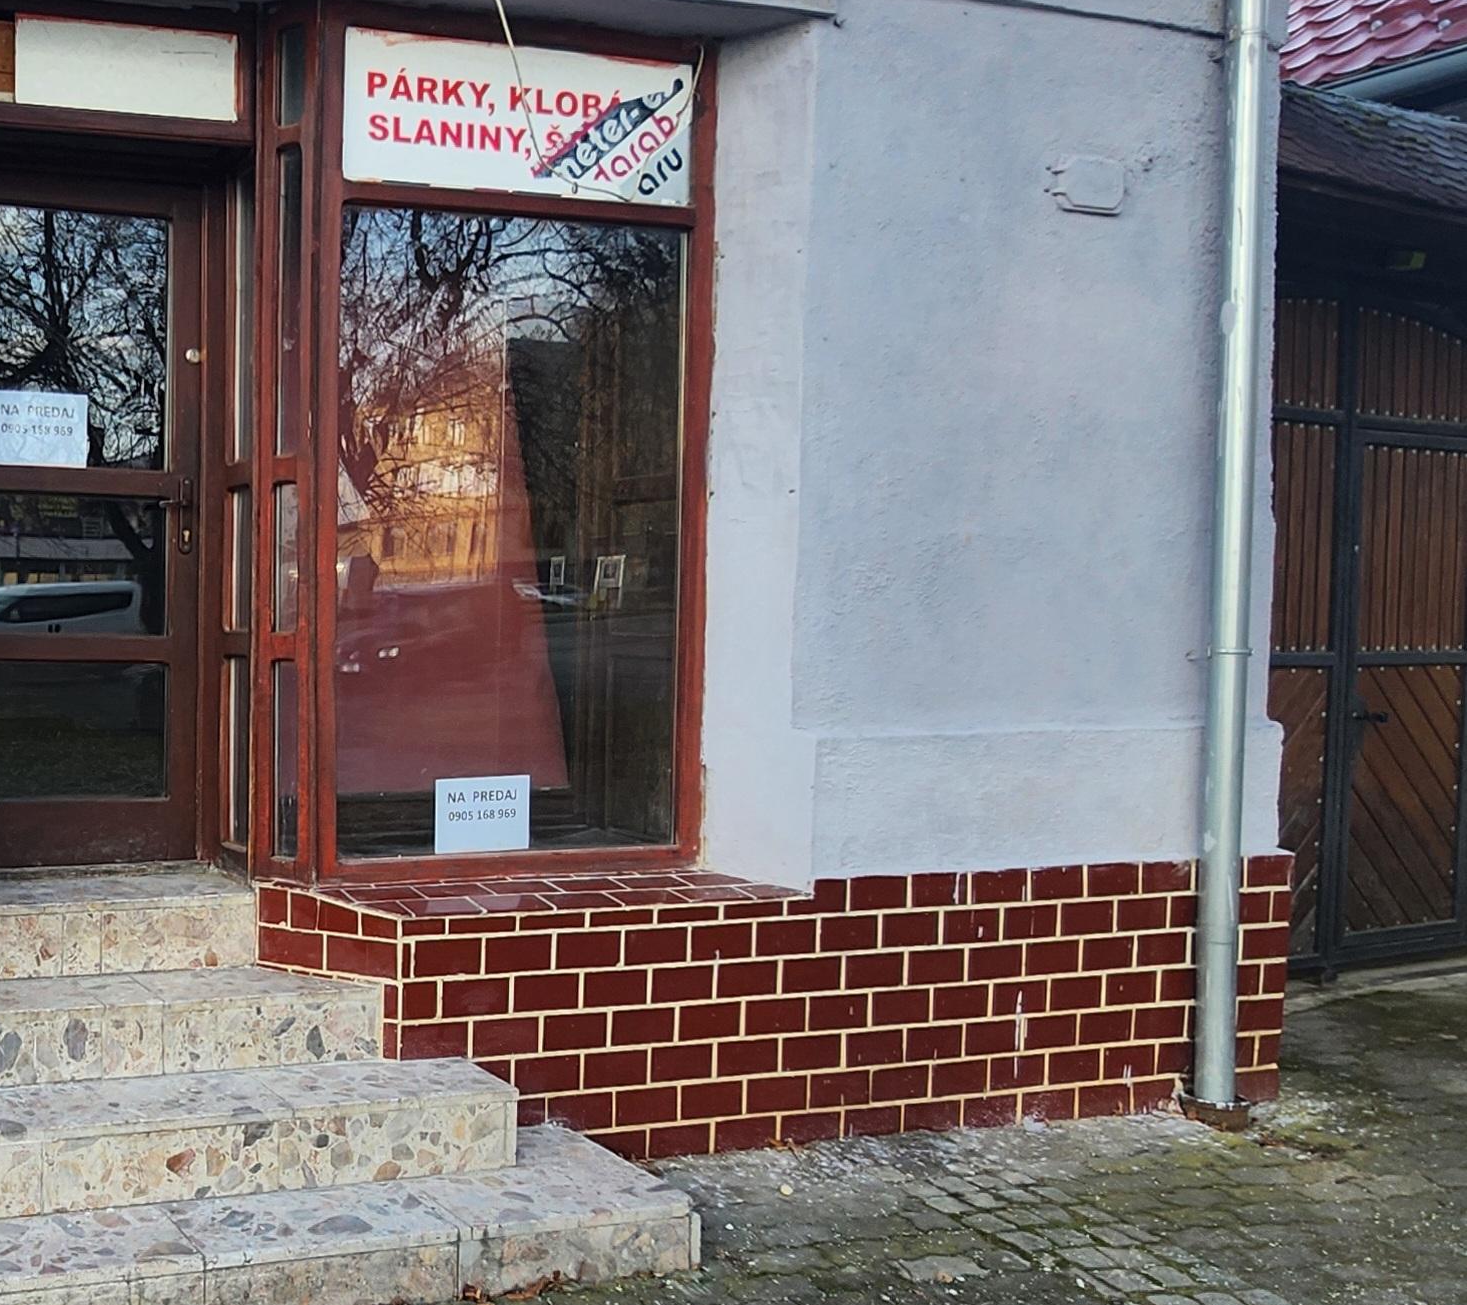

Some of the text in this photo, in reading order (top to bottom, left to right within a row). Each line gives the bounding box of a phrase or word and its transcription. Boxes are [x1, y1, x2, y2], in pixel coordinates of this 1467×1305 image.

[366, 67, 496, 116] PÁRKY,
[368, 114, 532, 160] SLANINY,
[0, 404, 75, 419] NA PREDAJ
[447, 788, 518, 804] NA PREDAJ
[448, 807, 517, 822] 0905 168 969
